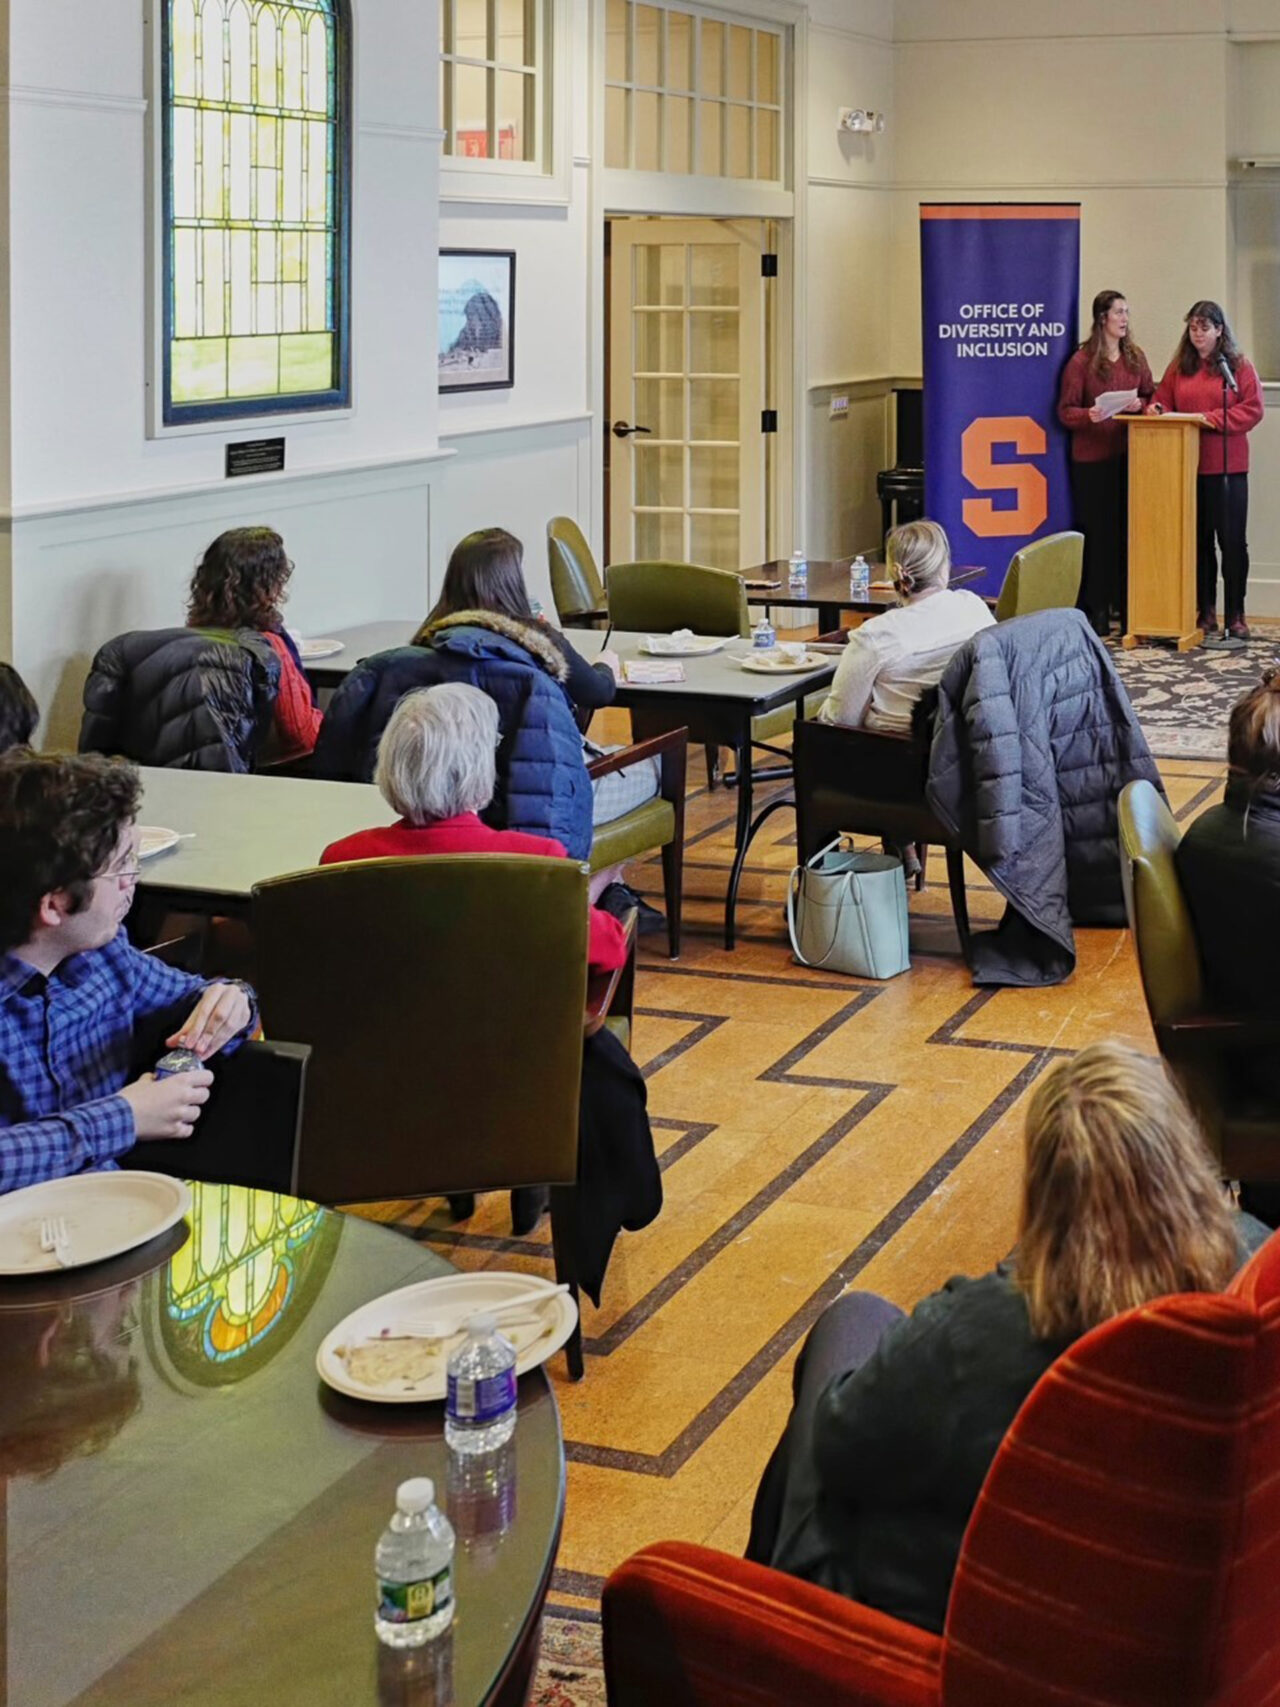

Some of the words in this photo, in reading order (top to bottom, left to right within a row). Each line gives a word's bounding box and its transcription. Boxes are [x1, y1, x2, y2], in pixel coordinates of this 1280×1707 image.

[959, 304, 1018, 319] OFFICE
[1021, 303, 1045, 318] OF
[939, 323, 1026, 339] DIVERSITY
[1028, 322, 1066, 337] AND
[957, 342, 1048, 357] INCLUSION
[961, 416, 1048, 538] S
